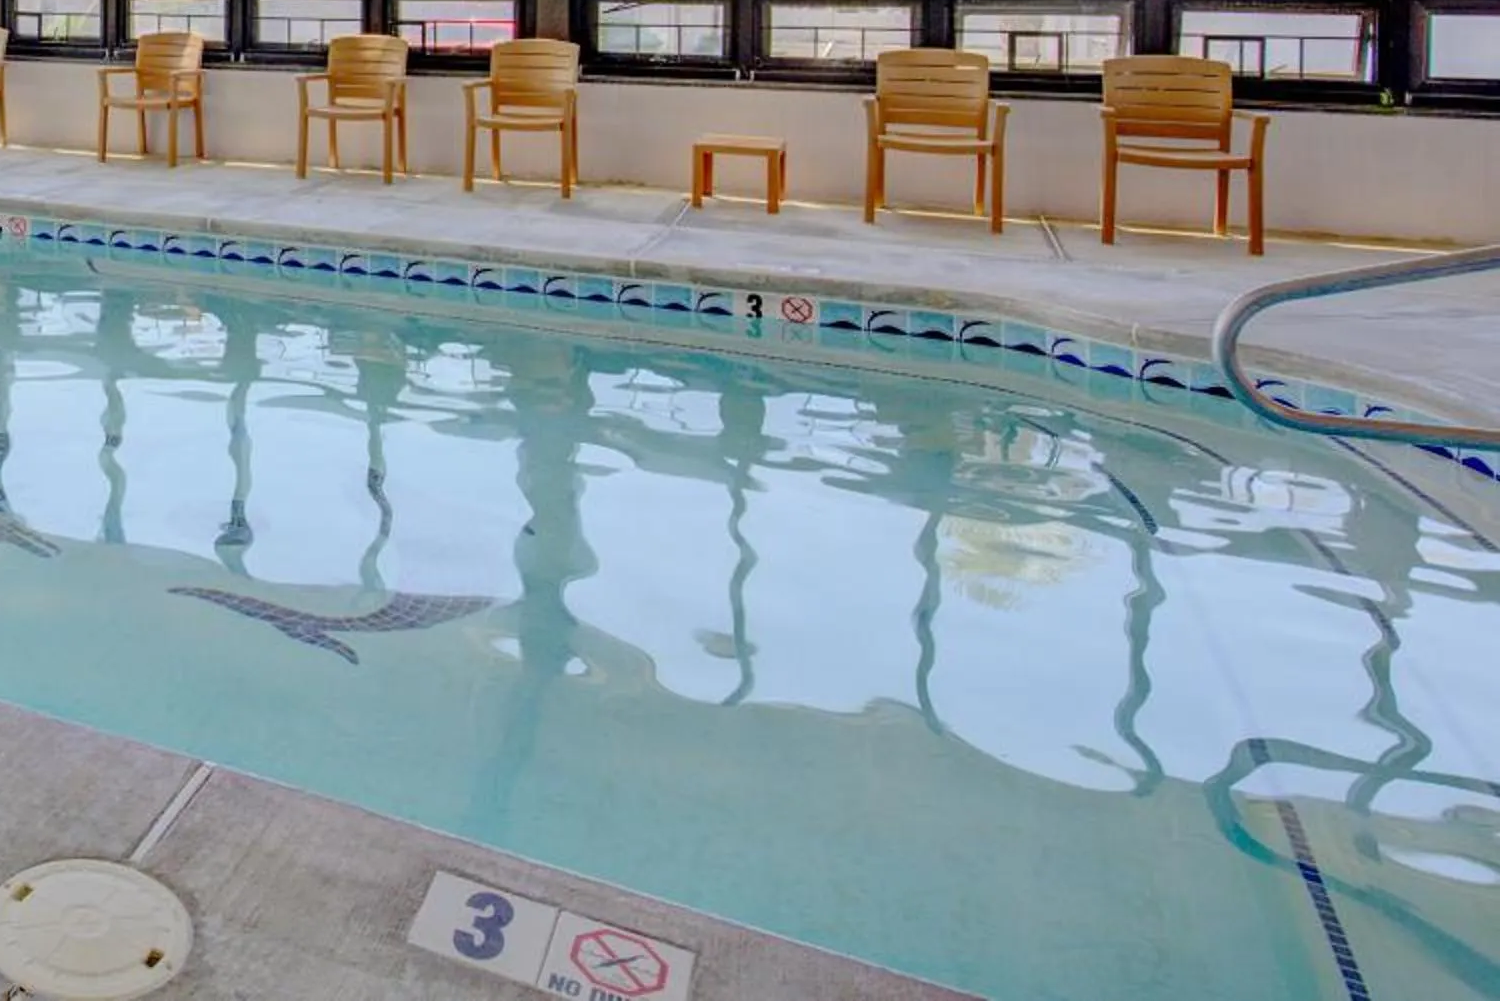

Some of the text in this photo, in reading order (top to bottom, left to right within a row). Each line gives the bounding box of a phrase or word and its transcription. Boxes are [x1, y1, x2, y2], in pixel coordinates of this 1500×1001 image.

[746, 293, 763, 318] 3
[453, 892, 514, 960] 3
[548, 973, 582, 997] NO
